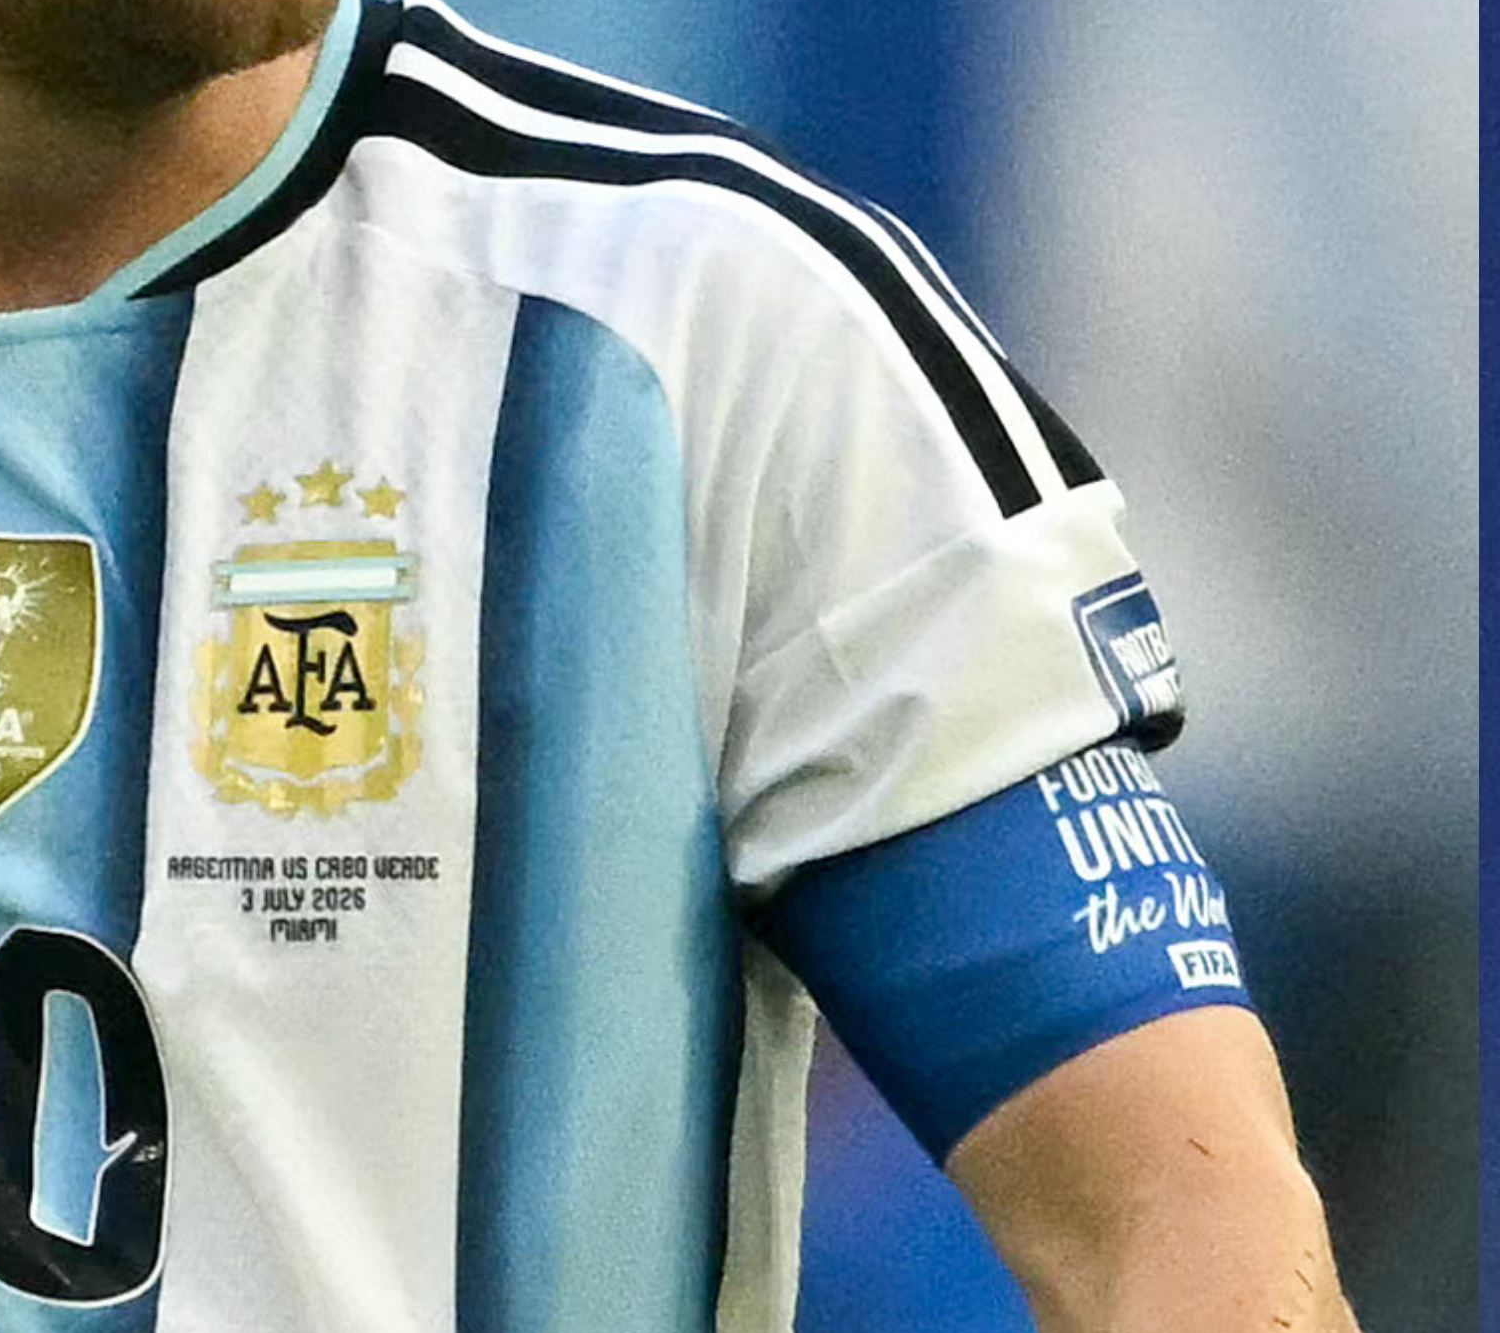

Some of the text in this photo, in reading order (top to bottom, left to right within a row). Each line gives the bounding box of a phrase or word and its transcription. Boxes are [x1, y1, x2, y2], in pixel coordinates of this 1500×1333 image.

[237, 610, 377, 736] AFA
[167, 856, 440, 881] ARGENTINA VS CABO VERDE
[242, 887, 367, 912] 3 JULY 2026
[269, 918, 338, 942] MIAMI
[1072, 881, 1167, 955] the
[1179, 949, 1236, 978] FIFA
